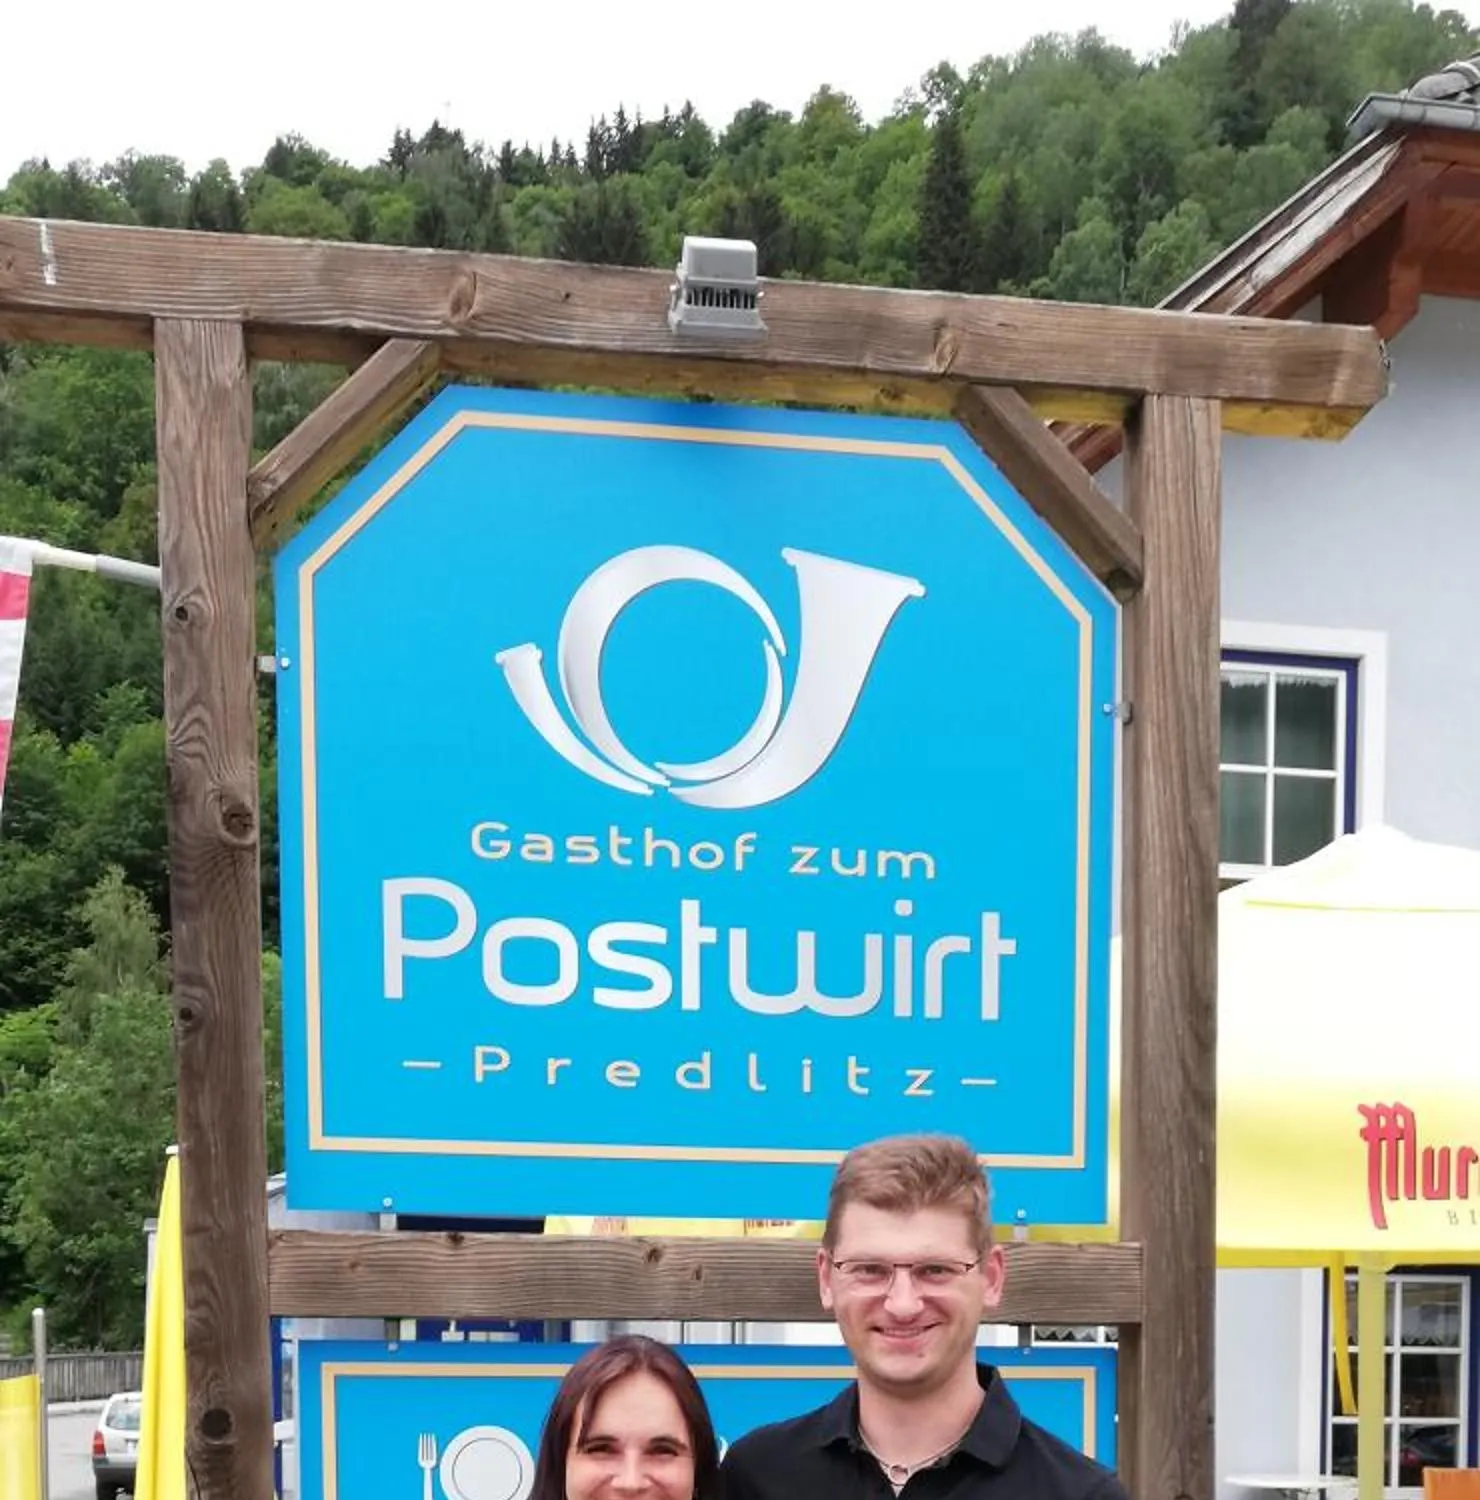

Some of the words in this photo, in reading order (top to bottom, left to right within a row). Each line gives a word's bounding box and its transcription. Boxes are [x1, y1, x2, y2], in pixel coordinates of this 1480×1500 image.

[470, 820, 758, 872] Gasthof
[789, 845, 937, 880] zum
[381, 876, 1018, 1022] Postwirt
[1357, 1101, 1480, 1230] Mur
